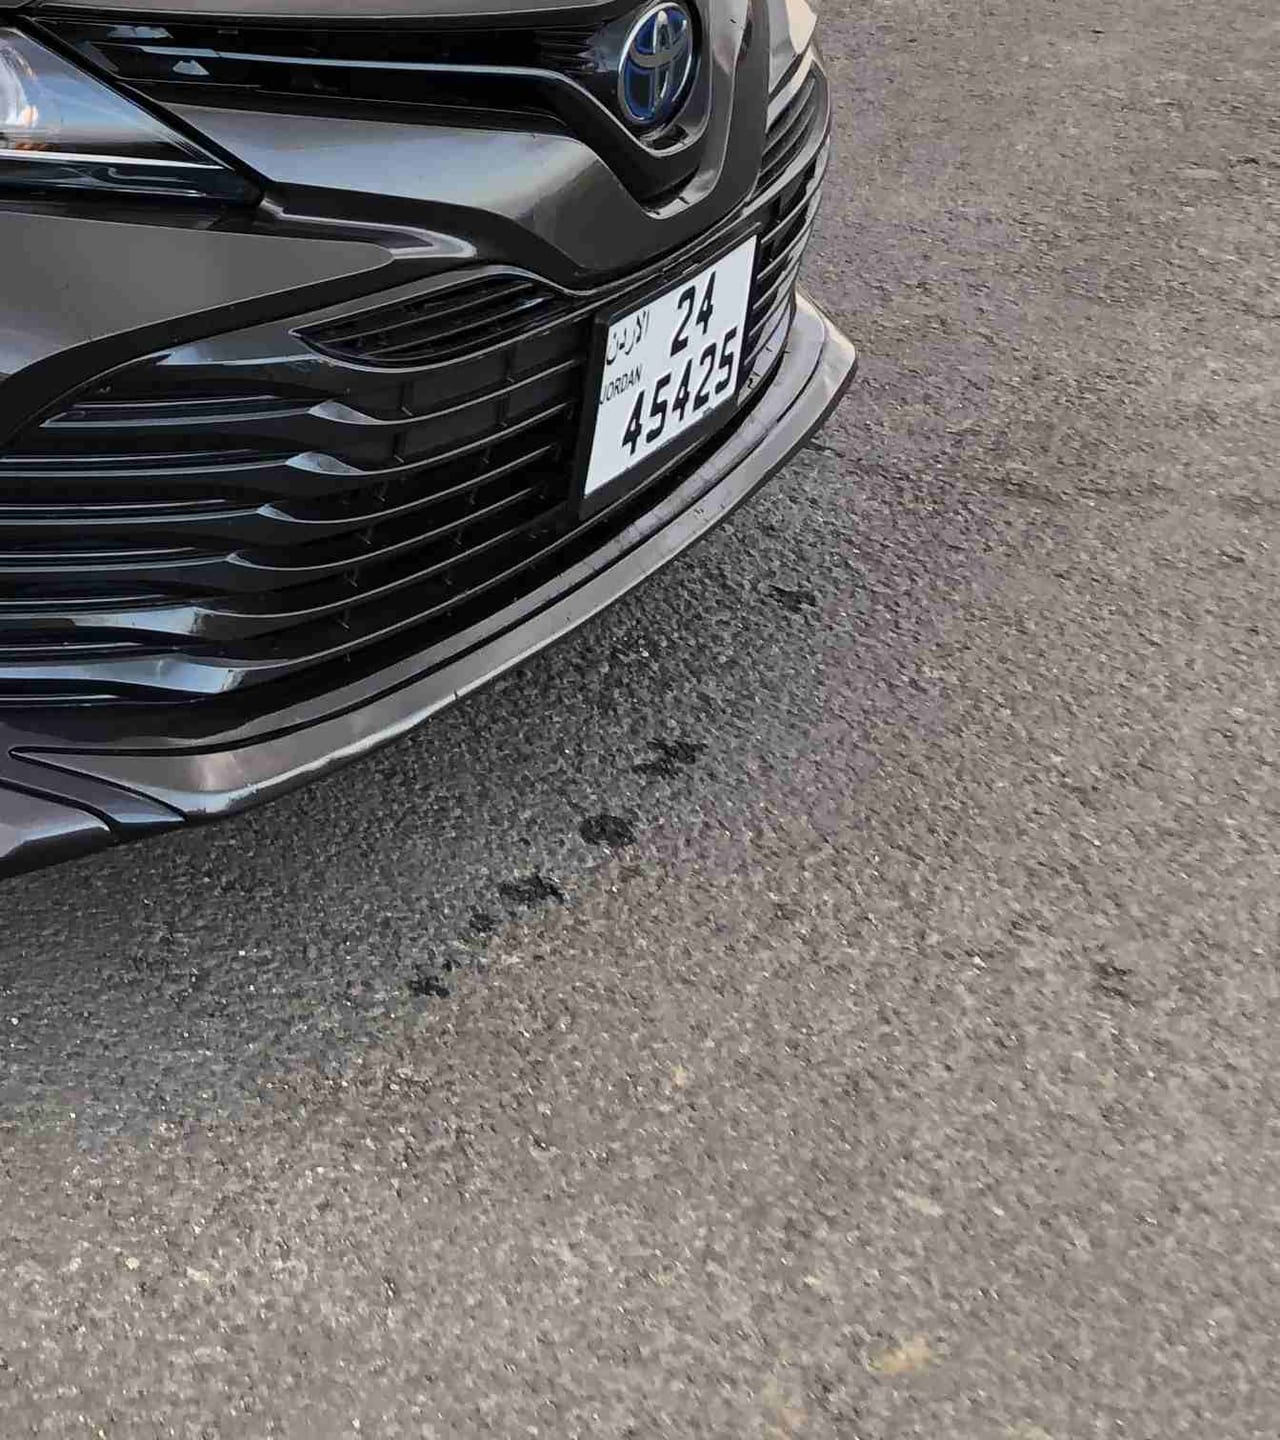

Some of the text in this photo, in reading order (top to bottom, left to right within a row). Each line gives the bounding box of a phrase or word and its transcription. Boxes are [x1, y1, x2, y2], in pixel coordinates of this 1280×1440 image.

[670, 269, 717, 358] 24
[599, 362, 643, 406] JORDAN
[622, 326, 737, 455] 45425
